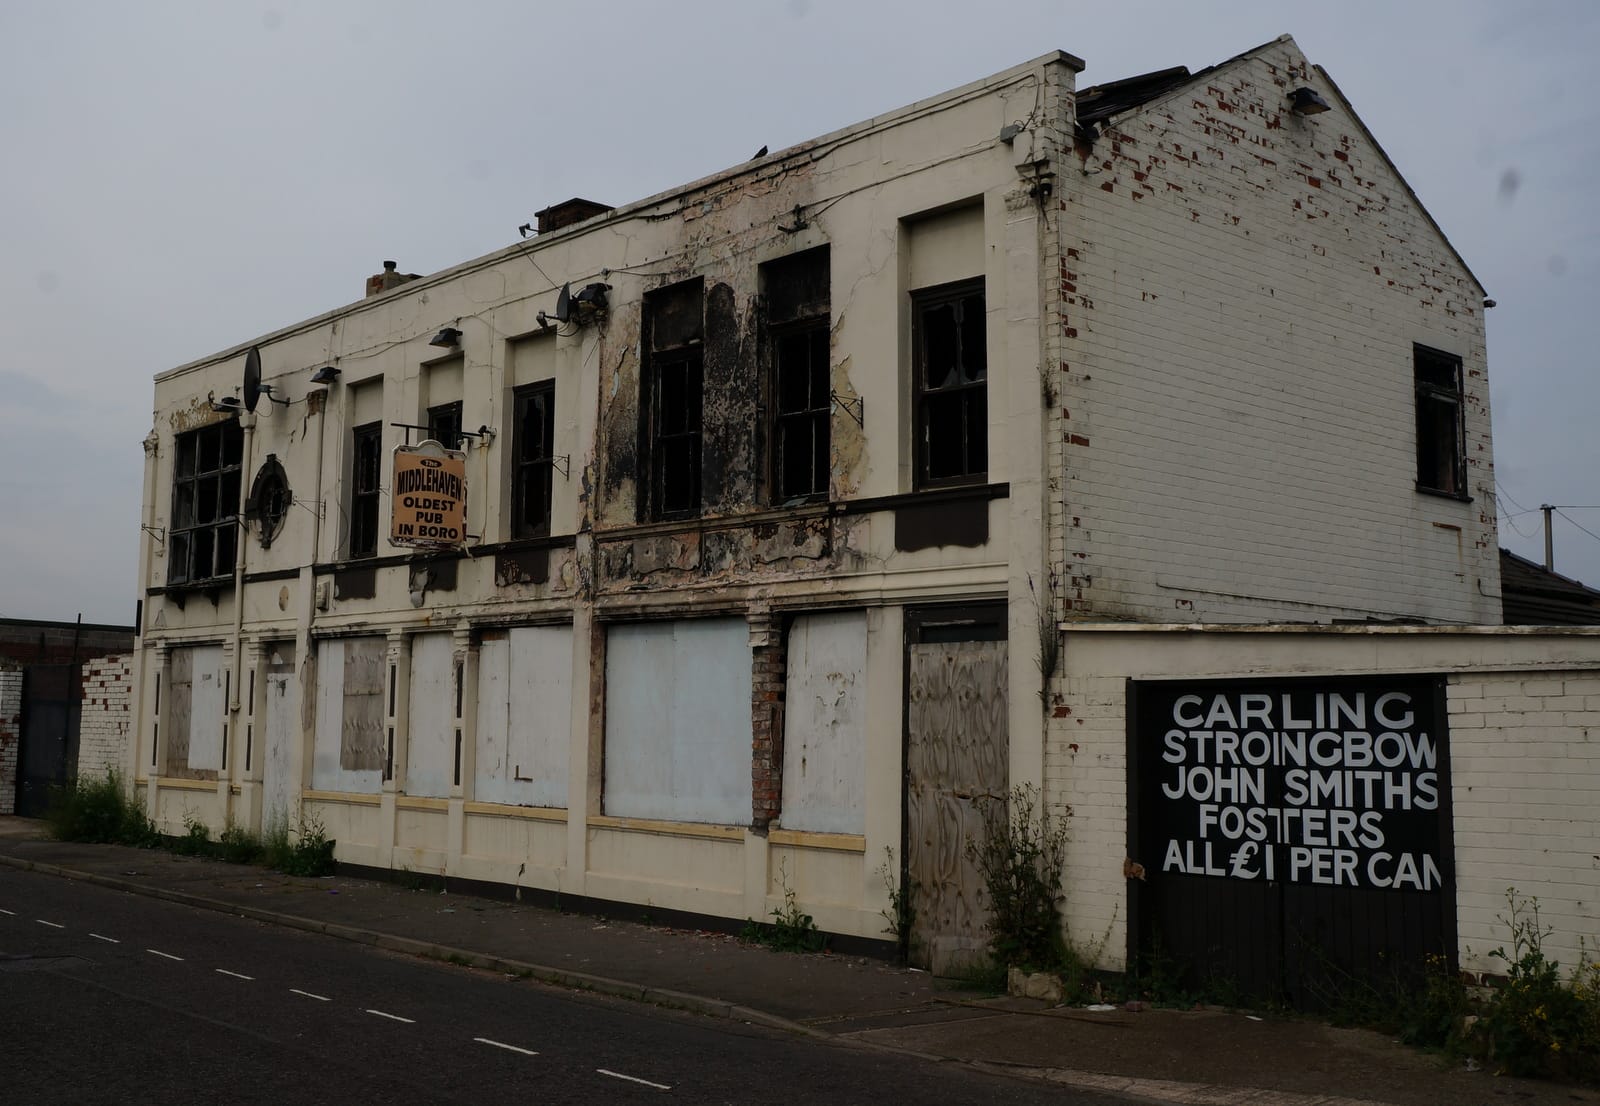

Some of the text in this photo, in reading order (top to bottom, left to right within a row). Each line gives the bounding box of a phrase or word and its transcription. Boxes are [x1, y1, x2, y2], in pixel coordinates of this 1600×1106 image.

[397, 468, 462, 501] MIDDLEHAVEN
[403, 496, 455, 511] OLDEST
[399, 524, 458, 539] IN BORO
[416, 511, 443, 524] PUB
[1172, 691, 1414, 730] CARLING
[1162, 729, 1437, 769] STRONGBOW
[1161, 766, 1438, 810] JOHN SMITHS
[1199, 804, 1385, 849] FOSTERS
[1162, 839, 1442, 891] ALL £1 PER CAN
